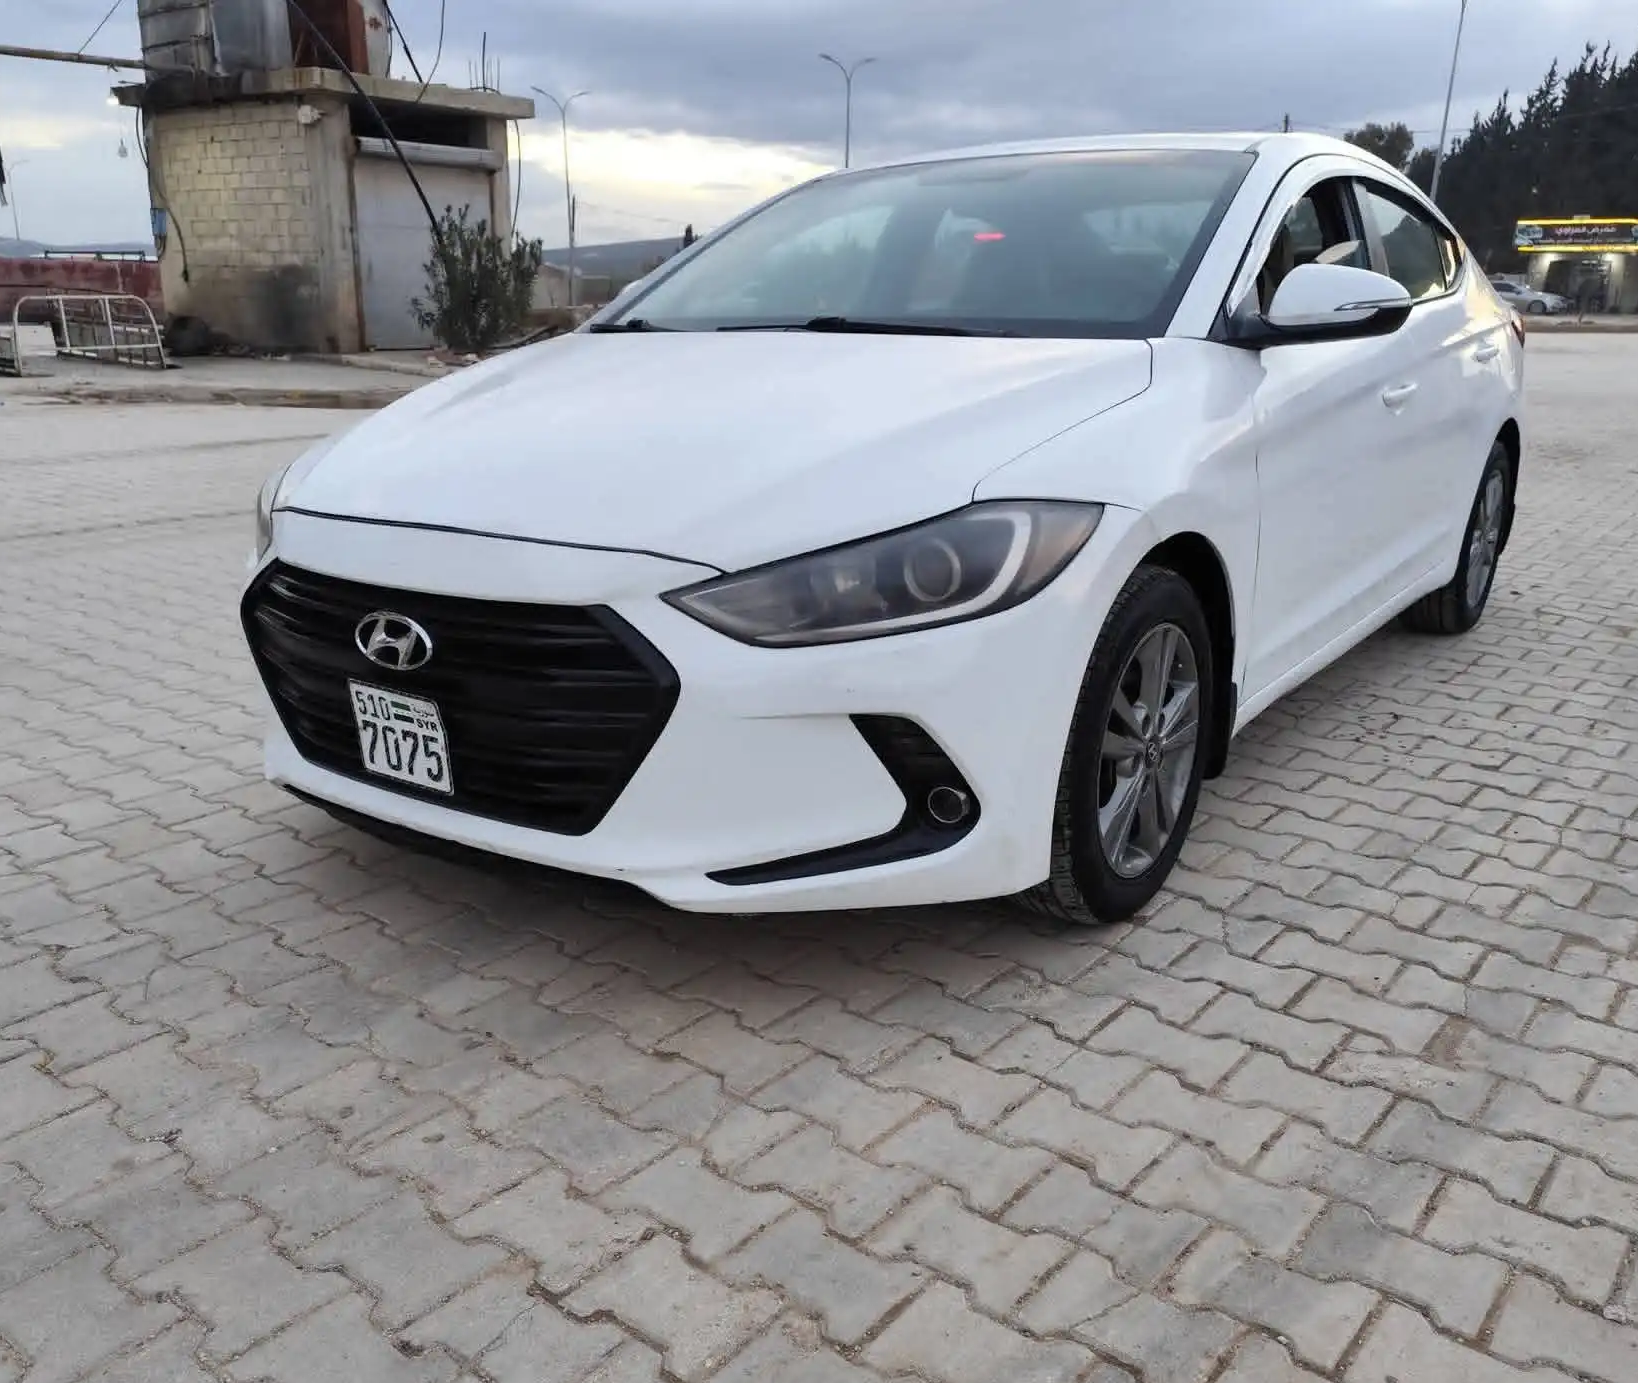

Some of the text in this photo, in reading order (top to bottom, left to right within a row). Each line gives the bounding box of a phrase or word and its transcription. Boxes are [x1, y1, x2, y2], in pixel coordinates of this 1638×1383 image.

[355, 690, 391, 721] 510
[416, 718, 439, 733] SYR
[362, 719, 444, 783] 7075
